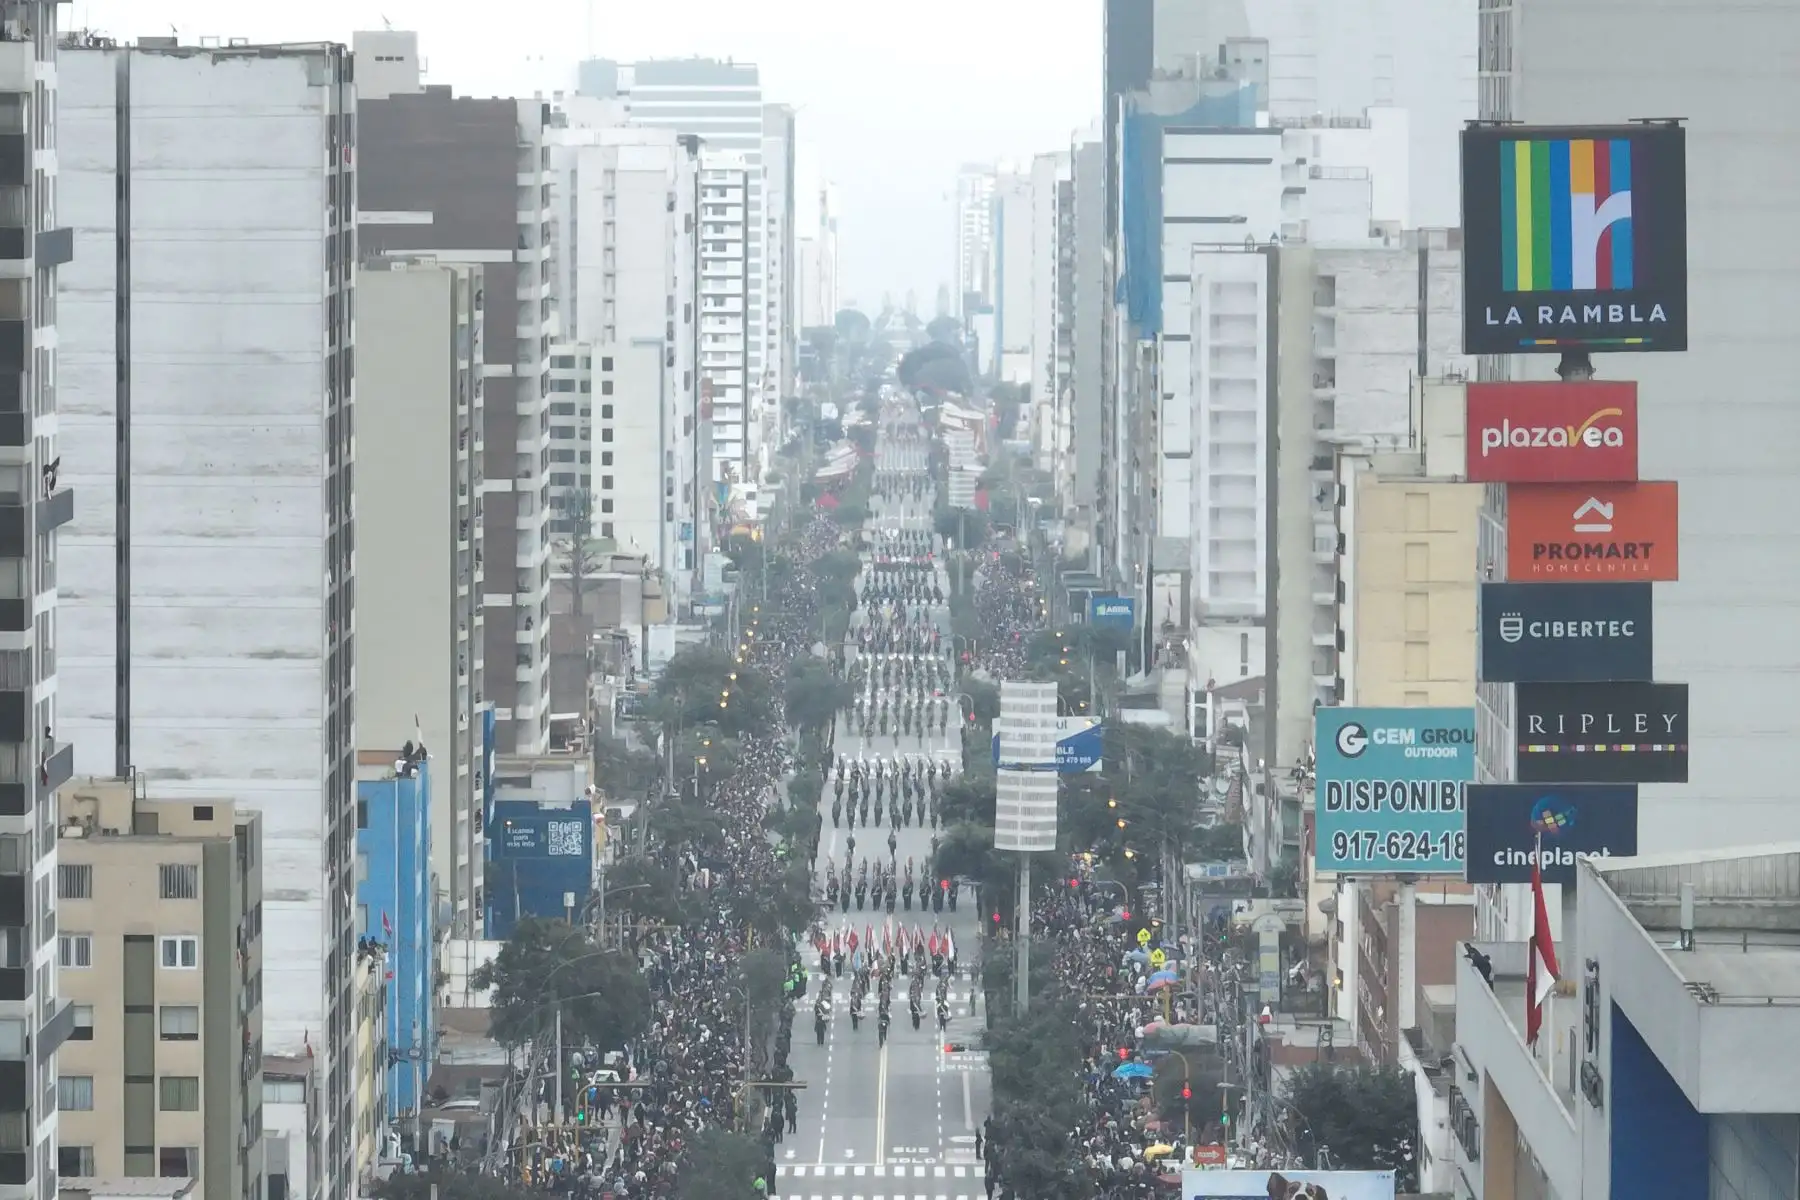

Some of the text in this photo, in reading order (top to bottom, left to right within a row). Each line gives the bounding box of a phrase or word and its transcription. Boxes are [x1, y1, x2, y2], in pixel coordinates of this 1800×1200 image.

[1486, 303, 1667, 325] LA RAMBLA
[1533, 542, 1654, 560] PROMART
[1532, 563, 1650, 573] HOMECENTER
[1529, 620, 1635, 638] CIBERTEC
[1528, 713, 1678, 734] RIPLEY
[1373, 728, 1475, 745] CEM GROU
[1404, 747, 1457, 758] OUTDOOR
[1333, 830, 1464, 861] 917-624-18
